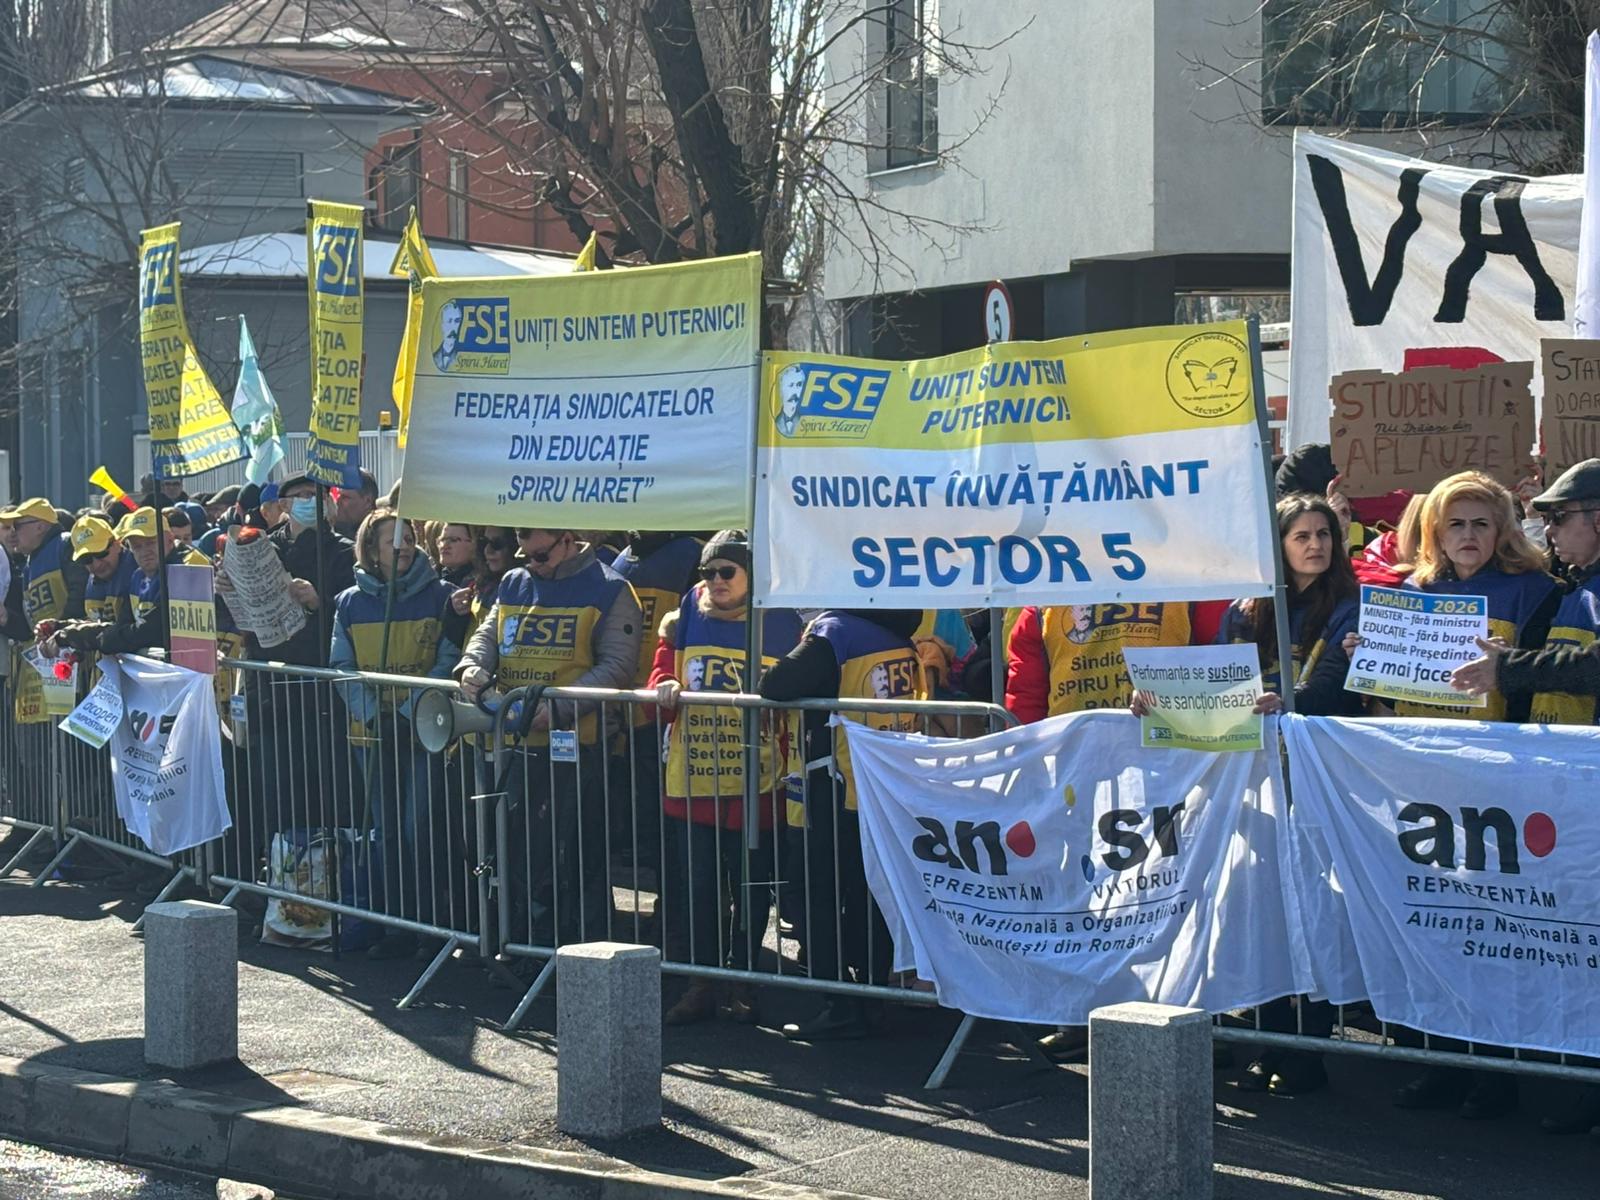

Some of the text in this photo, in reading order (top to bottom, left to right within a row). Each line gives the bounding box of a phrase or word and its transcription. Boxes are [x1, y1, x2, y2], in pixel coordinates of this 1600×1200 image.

[1306, 154, 1565, 326] VA
[459, 304, 508, 345] FSE
[514, 302, 746, 350] UNIȚI SUNTEM PUTERNICI!
[993, 300, 1002, 339] 5
[455, 355, 509, 370] Spiru Haret
[800, 371, 886, 413] FSE
[910, 359, 1066, 403] UNIȚI SUNTEM
[454, 387, 714, 427] FEDERAȚIA SINDICATELOR
[921, 394, 1071, 434] PUTERNICI!
[799, 418, 869, 437] Spiru Haret
[508, 434, 649, 469] DIN EDUCAȚIE
[497, 475, 654, 505] „SPIRU HARET”
[792, 460, 1209, 516] SINDICAT ÎNVĂȚĂMÂNT
[852, 533, 1147, 588] SECTOR 5
[1094, 602, 1159, 625] FSE
[1370, 591, 1478, 614] ROMÂNIA 2026
[171, 603, 216, 633] BRĂILA
[516, 615, 575, 644] FSE
[1364, 607, 1402, 621] MINISTER
[1410, 614, 1430, 626] fără
[1432, 617, 1480, 628] ministru
[1362, 622, 1407, 639] EDUCAȚIE
[1416, 629, 1439, 643] fără
[1442, 632, 1475, 646] buge
[1071, 651, 1124, 671] Sindic
[1361, 638, 1477, 661] Domnule Președinte
[501, 667, 557, 680] Sindicat
[704, 659, 744, 692] FS
[1132, 663, 1190, 684] Performanța
[1192, 666, 1206, 680] se
[1208, 662, 1254, 684] susține,
[1355, 657, 1452, 683] ce mai face
[1160, 696, 1172, 710] se
[1174, 690, 1257, 715] sancționează!
[689, 714, 742, 728] Sindic
[923, 873, 1043, 901] EPREZENTĂM
[1407, 875, 1557, 908] REPREZENTĂM
[971, 912, 1057, 933] Națională
[1066, 921, 1074, 933] a
[1406, 911, 1598, 946] Alianța Națională a
[1054, 939, 1082, 954] din
[1463, 940, 1578, 969] Studențești
